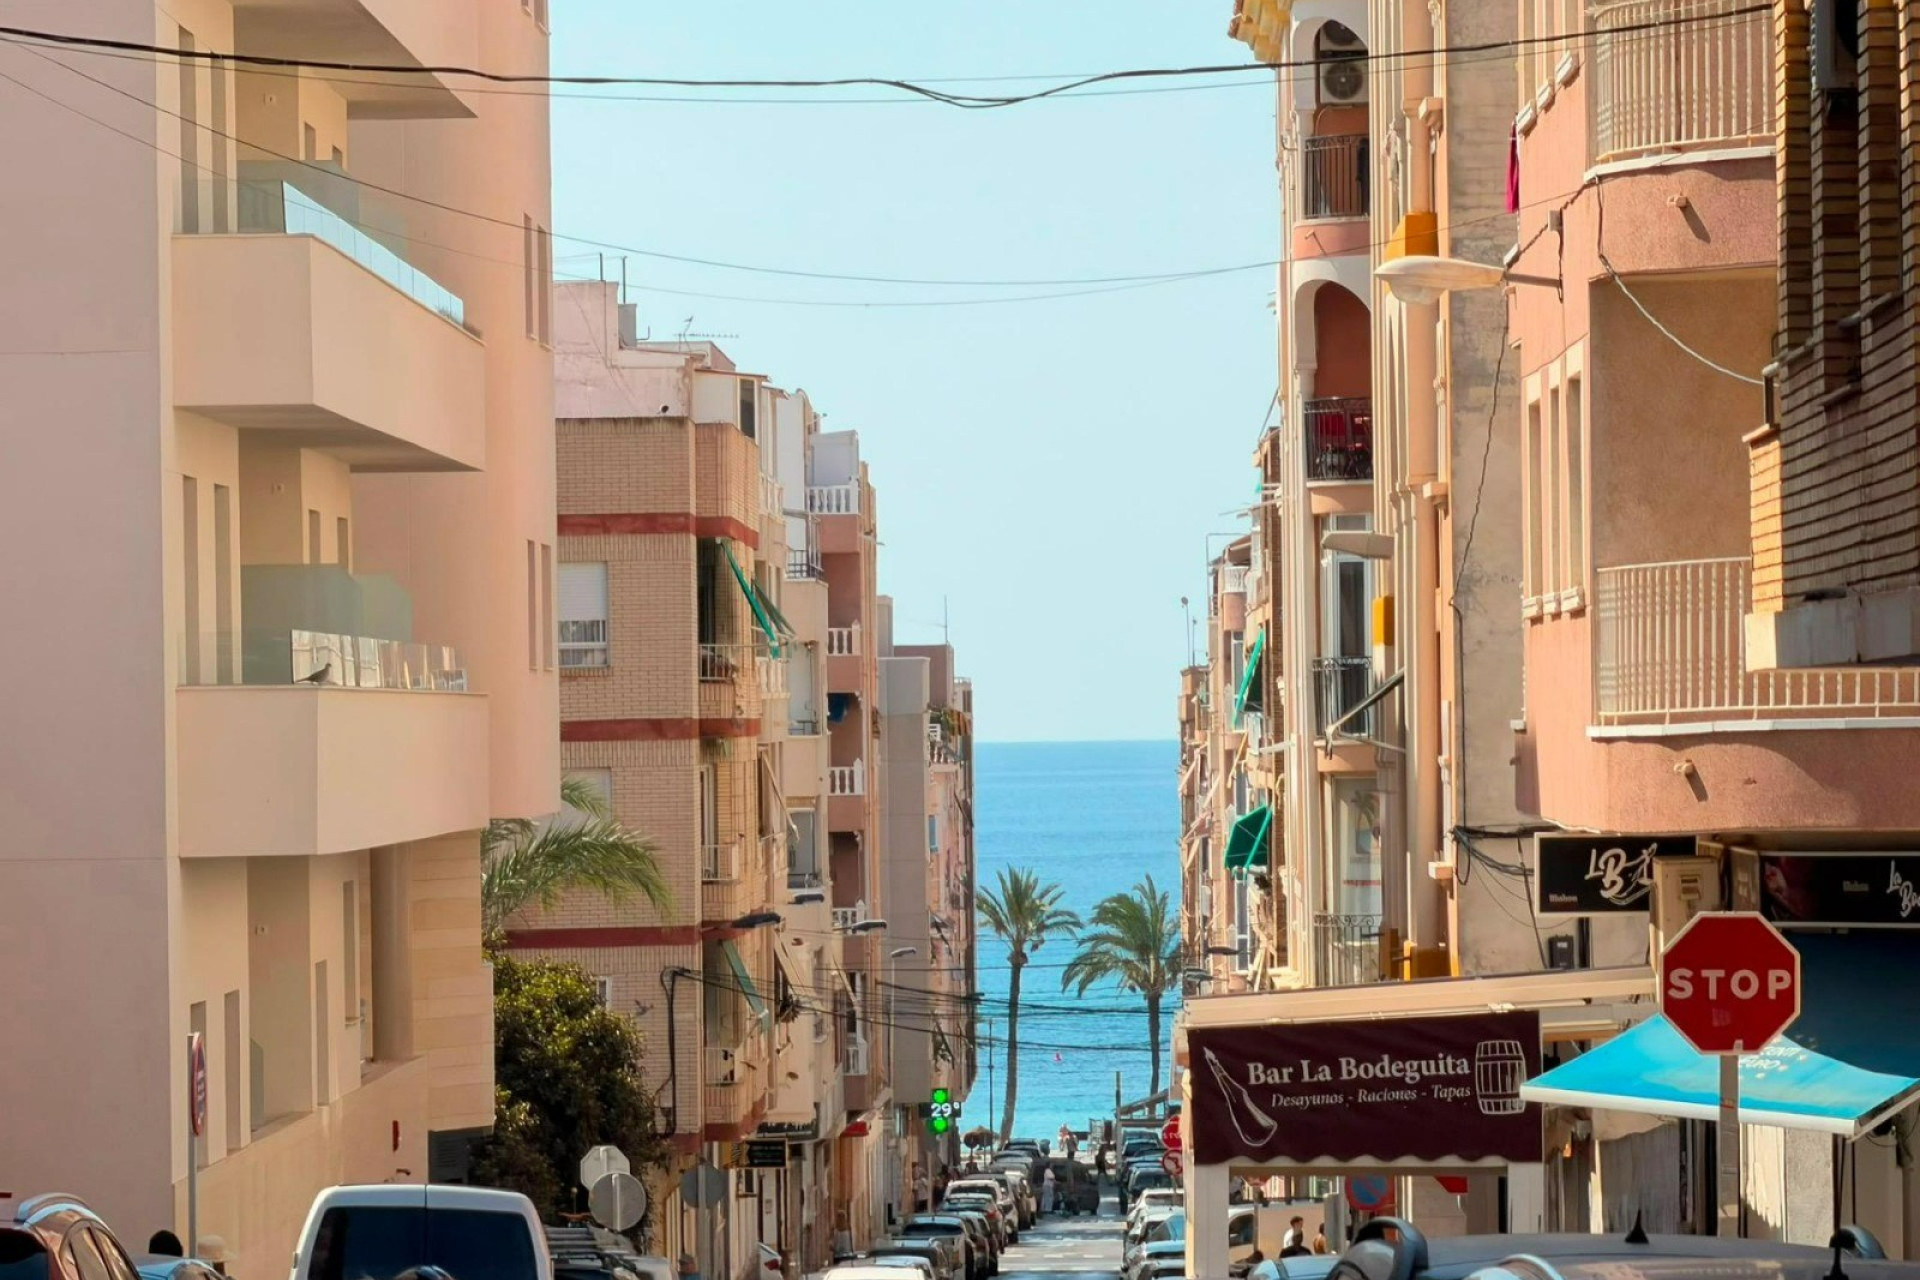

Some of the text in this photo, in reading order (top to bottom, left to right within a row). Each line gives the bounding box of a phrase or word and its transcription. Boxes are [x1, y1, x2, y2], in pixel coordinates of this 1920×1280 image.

[1667, 968, 1792, 1000] STOP
[1247, 1053, 1470, 1085] Bar La Bodeguita
[1271, 1093, 1345, 1110] Desayunos
[1357, 1087, 1418, 1103] Raciones
[1431, 1084, 1471, 1101] Tapas
